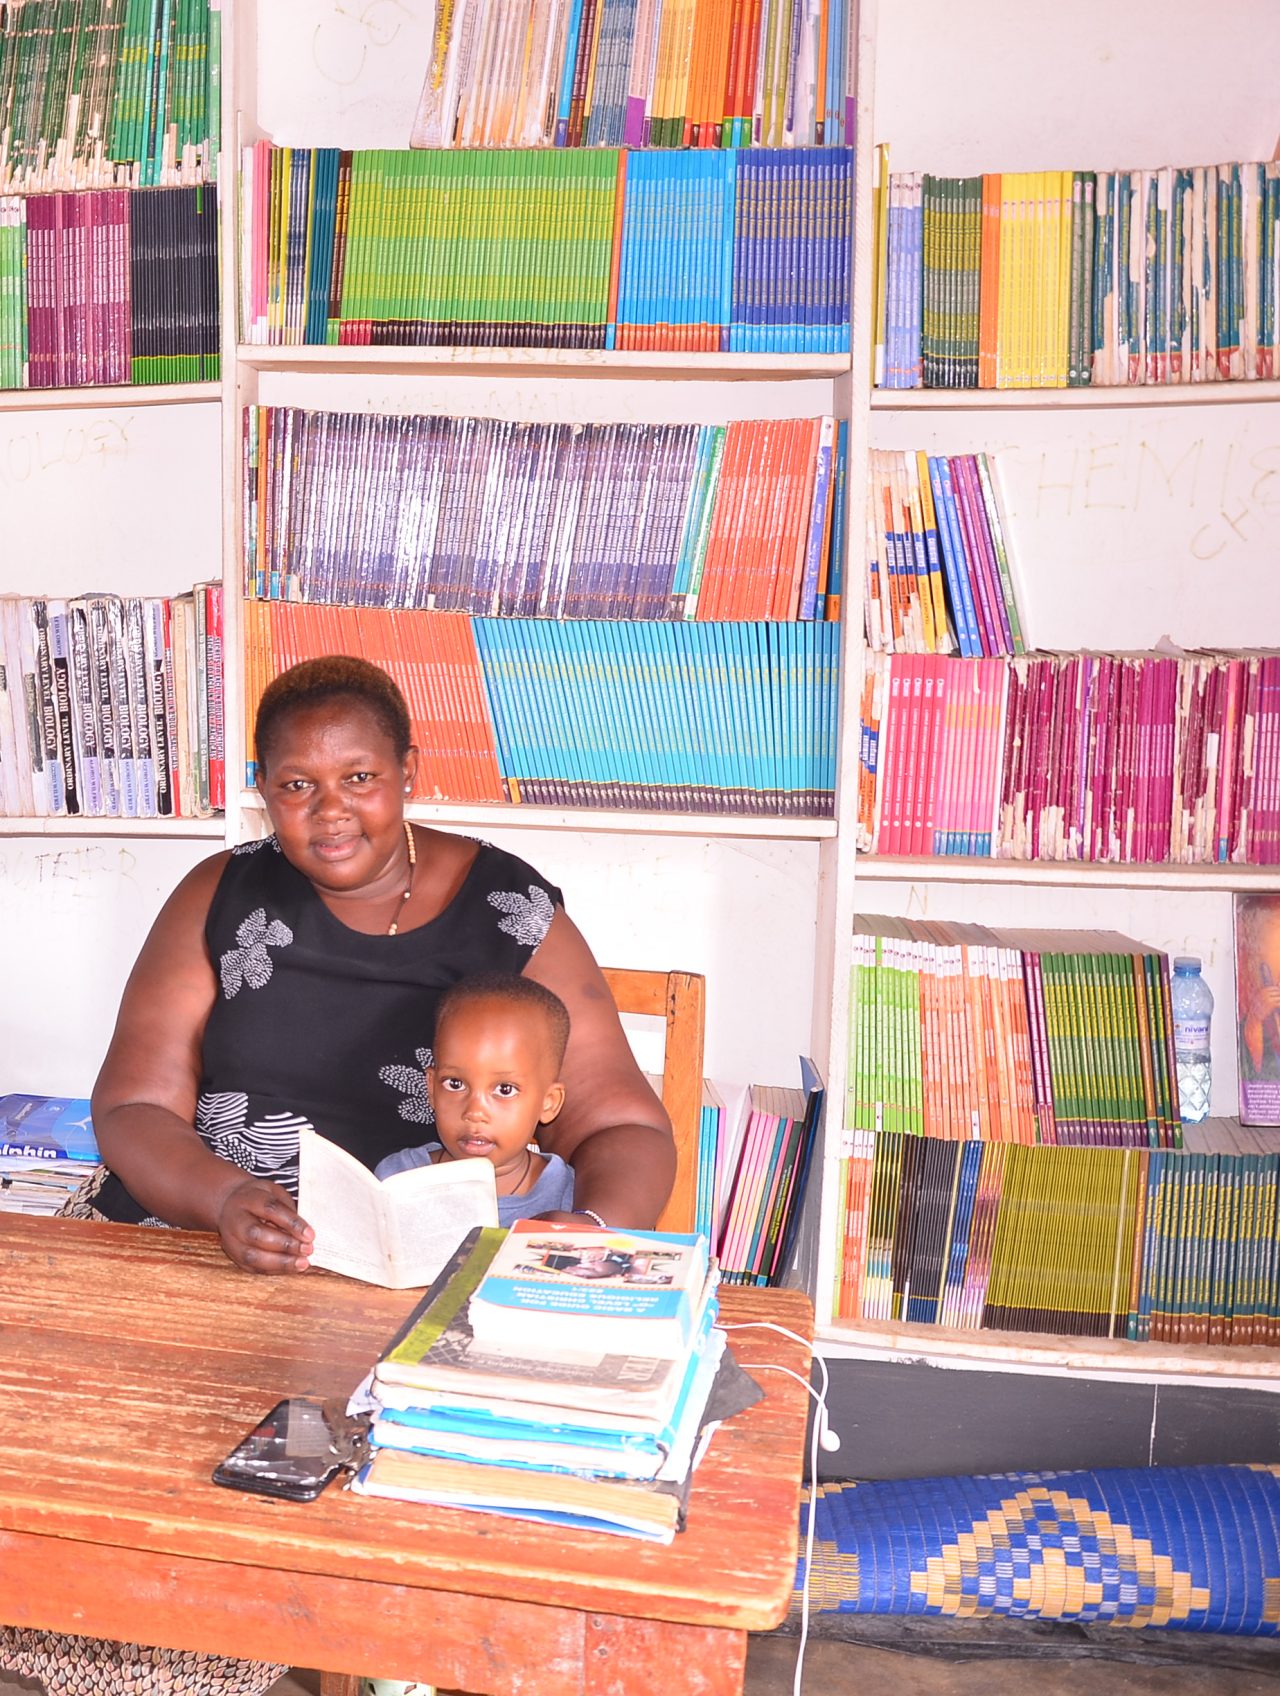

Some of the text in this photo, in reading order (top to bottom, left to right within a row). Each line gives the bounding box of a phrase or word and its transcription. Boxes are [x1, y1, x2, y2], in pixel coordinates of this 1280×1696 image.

[38, 628, 56, 750] ORDINARY LEVEL BIOLOGY
[99, 671, 109, 699] LEVEL
[56, 667, 74, 790] ORDINARY LEVEL BIOLOGY
[83, 703, 95, 747] BIOLOGY
[102, 705, 113, 749] BIOLOGY
[120, 705, 131, 749] BIOLOGY
[136, 704, 147, 748] BIOLOGY
[153, 671, 167, 793] ORDINARY LEVEL BIOLOGY
[512, 1286, 659, 1302] RELIGIOUS EDUCATION
[516, 1292, 586, 1303] CHRISTIAN
[520, 1298, 548, 1306] FOR
